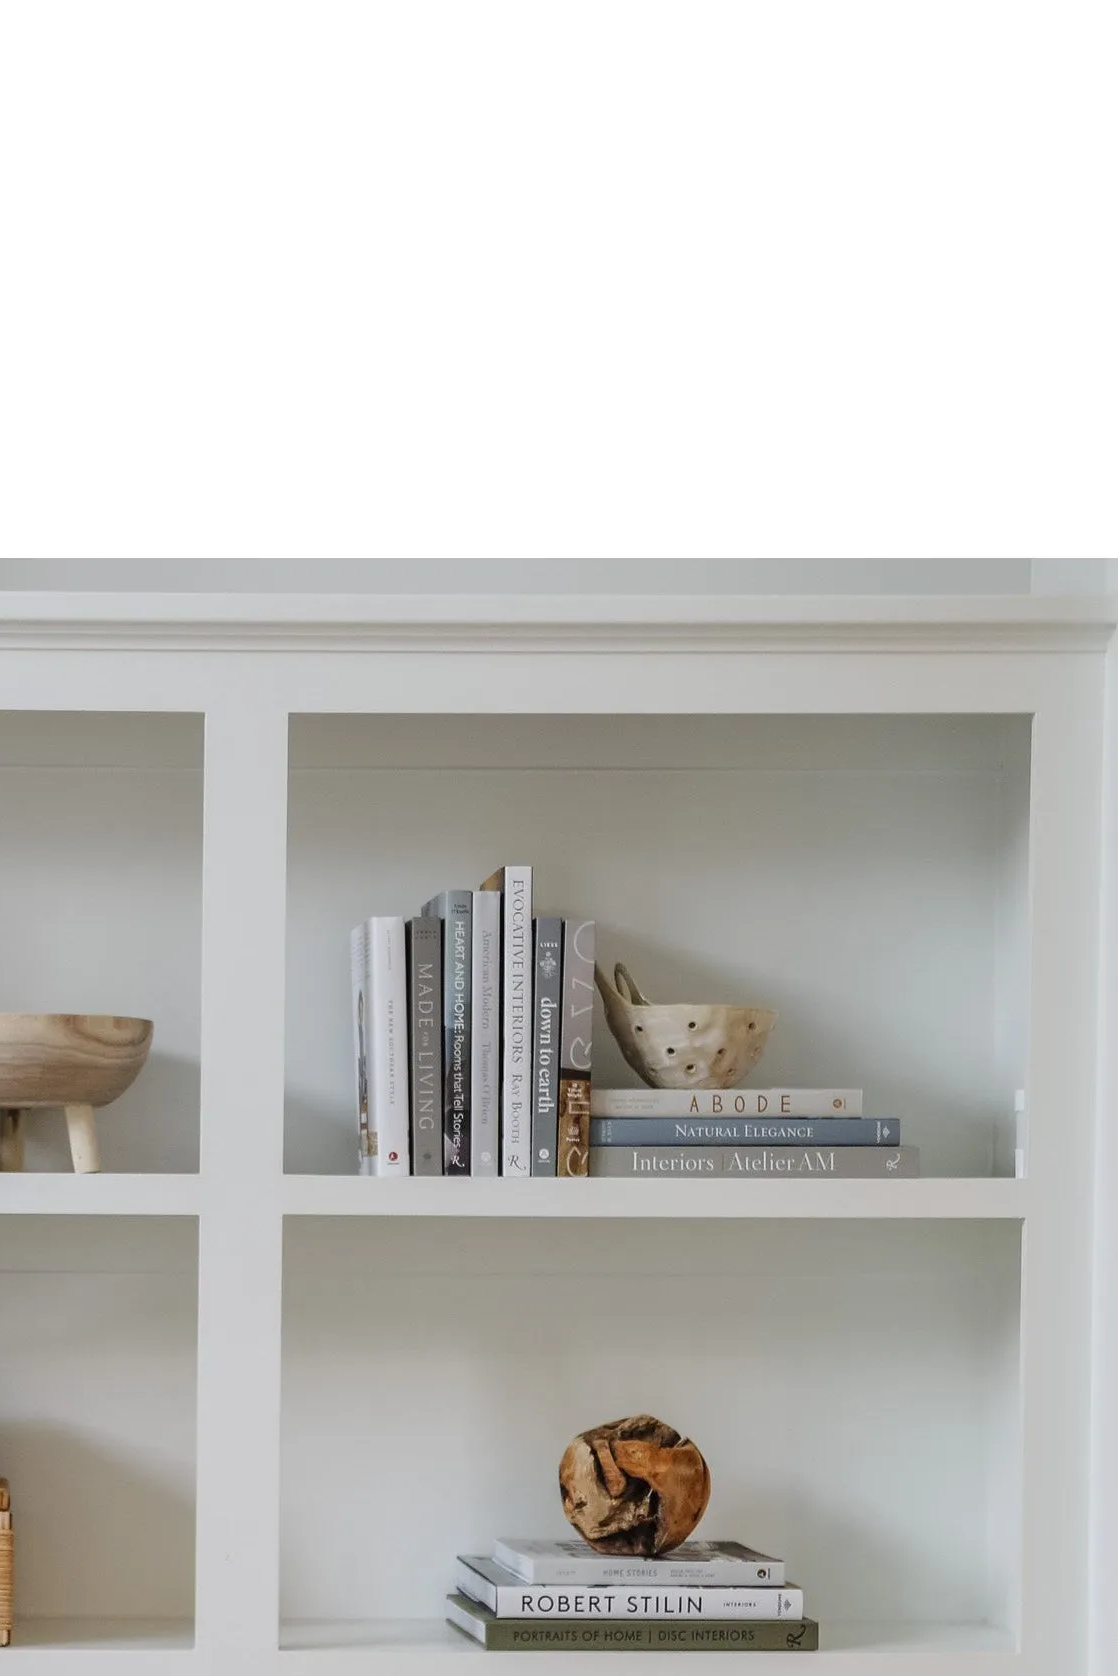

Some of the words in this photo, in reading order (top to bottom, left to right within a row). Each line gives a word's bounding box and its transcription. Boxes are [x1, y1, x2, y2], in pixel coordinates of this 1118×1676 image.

[454, 920, 465, 960] HEART
[512, 879, 525, 969] EVOCATIVE
[481, 929, 493, 983] American
[418, 963, 434, 1028] MADE
[454, 963, 465, 992] AND
[454, 993, 465, 1034] HOME:
[481, 986, 493, 1029] Modern
[512, 974, 524, 1063] INTERIORS
[539, 997, 557, 1045] down
[453, 1034, 465, 1072] Rooms
[539, 1047, 555, 1066] to
[417, 1050, 434, 1131] LIVING
[453, 1072, 465, 1094] that
[538, 1068, 555, 1114] earth
[453, 1095, 464, 1112] Tell
[689, 1095, 792, 1113] ABODE
[452, 1113, 464, 1148] Stories
[675, 1124, 741, 1139] NATURAL
[744, 1124, 814, 1139] ELEGANCE
[632, 1152, 715, 1172] Interiors
[728, 1152, 795, 1172] Atelier
[797, 1152, 836, 1172] AM
[602, 1568, 624, 1578] HOME
[626, 1568, 658, 1578] STORIES
[522, 1594, 616, 1614] ROBERT
[626, 1595, 703, 1614] STILIN
[513, 1630, 578, 1642] PORTRAITS
[581, 1630, 599, 1642] OF
[604, 1630, 642, 1642] HOME
[658, 1630, 686, 1642] DISC
[690, 1630, 755, 1642] INTERIORS
